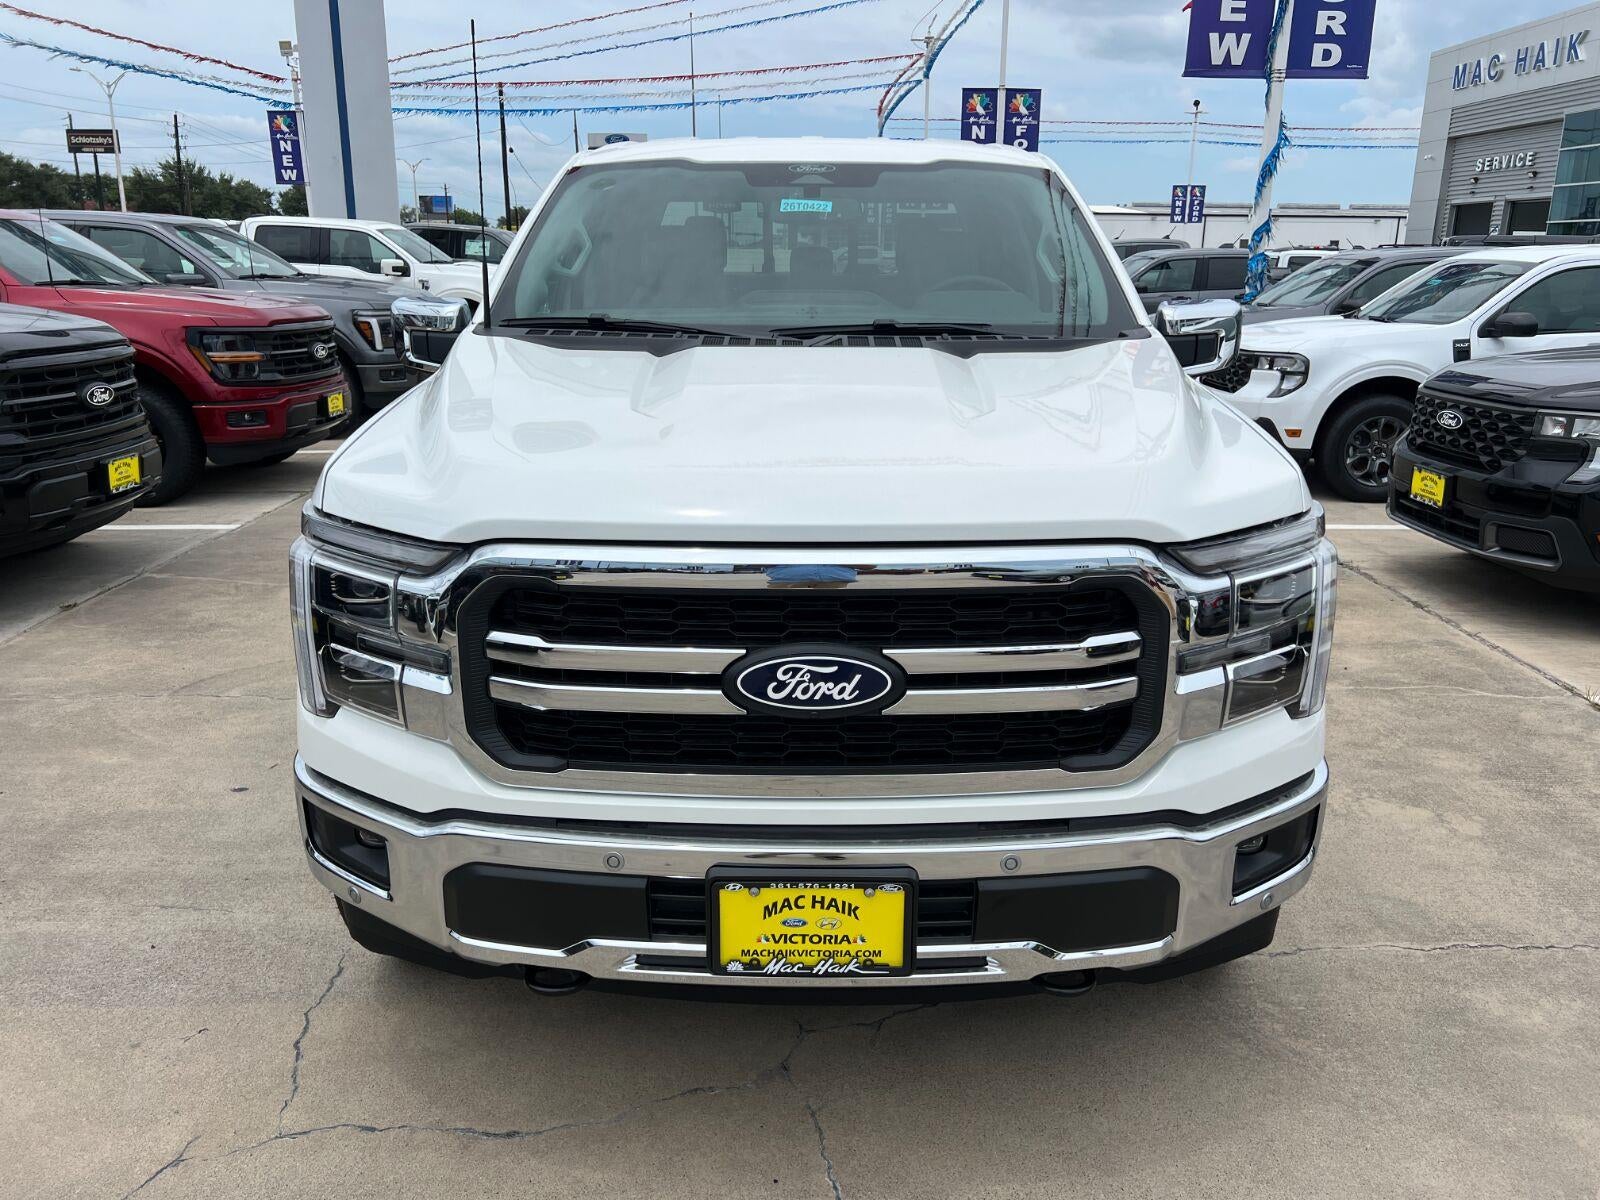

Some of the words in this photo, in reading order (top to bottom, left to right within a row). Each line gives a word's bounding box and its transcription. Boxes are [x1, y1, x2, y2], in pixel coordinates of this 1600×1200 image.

[1209, 0, 1251, 66] EW
[1452, 53, 1504, 91] MAC
[1514, 30, 1589, 76] HAIK
[71, 136, 112, 144] Schlotzsky's
[1013, 125, 1028, 149] FO
[280, 140, 297, 181] NEW
[796, 164, 828, 174] Ford
[1475, 152, 1535, 172] SERVICE
[783, 201, 828, 211] 26T0422
[1174, 200, 1183, 222] NEW
[1192, 200, 1200, 222] FORD
[93, 388, 110, 402] Ford
[1440, 412, 1458, 427] Ford
[767, 663, 862, 701] Ford
[763, 895, 806, 920] MAC
[811, 895, 860, 921] HAIK
[785, 919, 804, 927] Ford
[770, 934, 852, 945] VICTORIA
[741, 949, 882, 958] MACHAIKVICTORIA.COM
[763, 958, 810, 975] Mac
[812, 958, 864, 975] Haik
